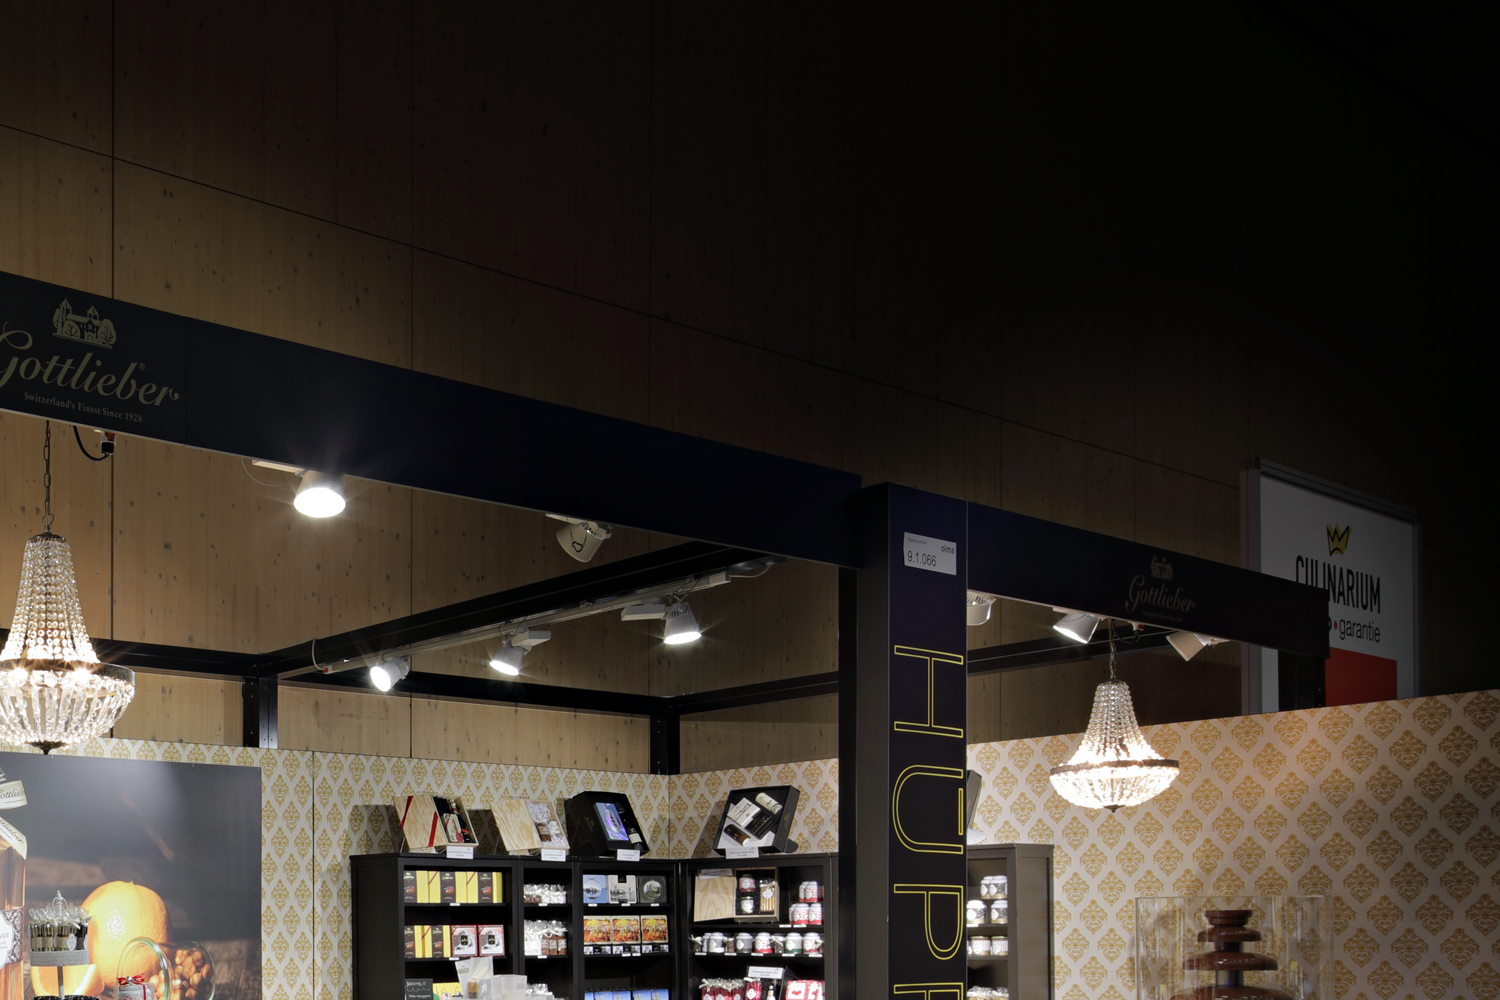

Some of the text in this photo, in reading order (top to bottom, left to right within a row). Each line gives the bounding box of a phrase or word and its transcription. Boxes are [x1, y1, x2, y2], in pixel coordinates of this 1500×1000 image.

[24, 391, 143, 423] Switzerland's Finest Since 1928
[940, 544, 955, 555] olma
[907, 550, 937, 567] 9.1.066
